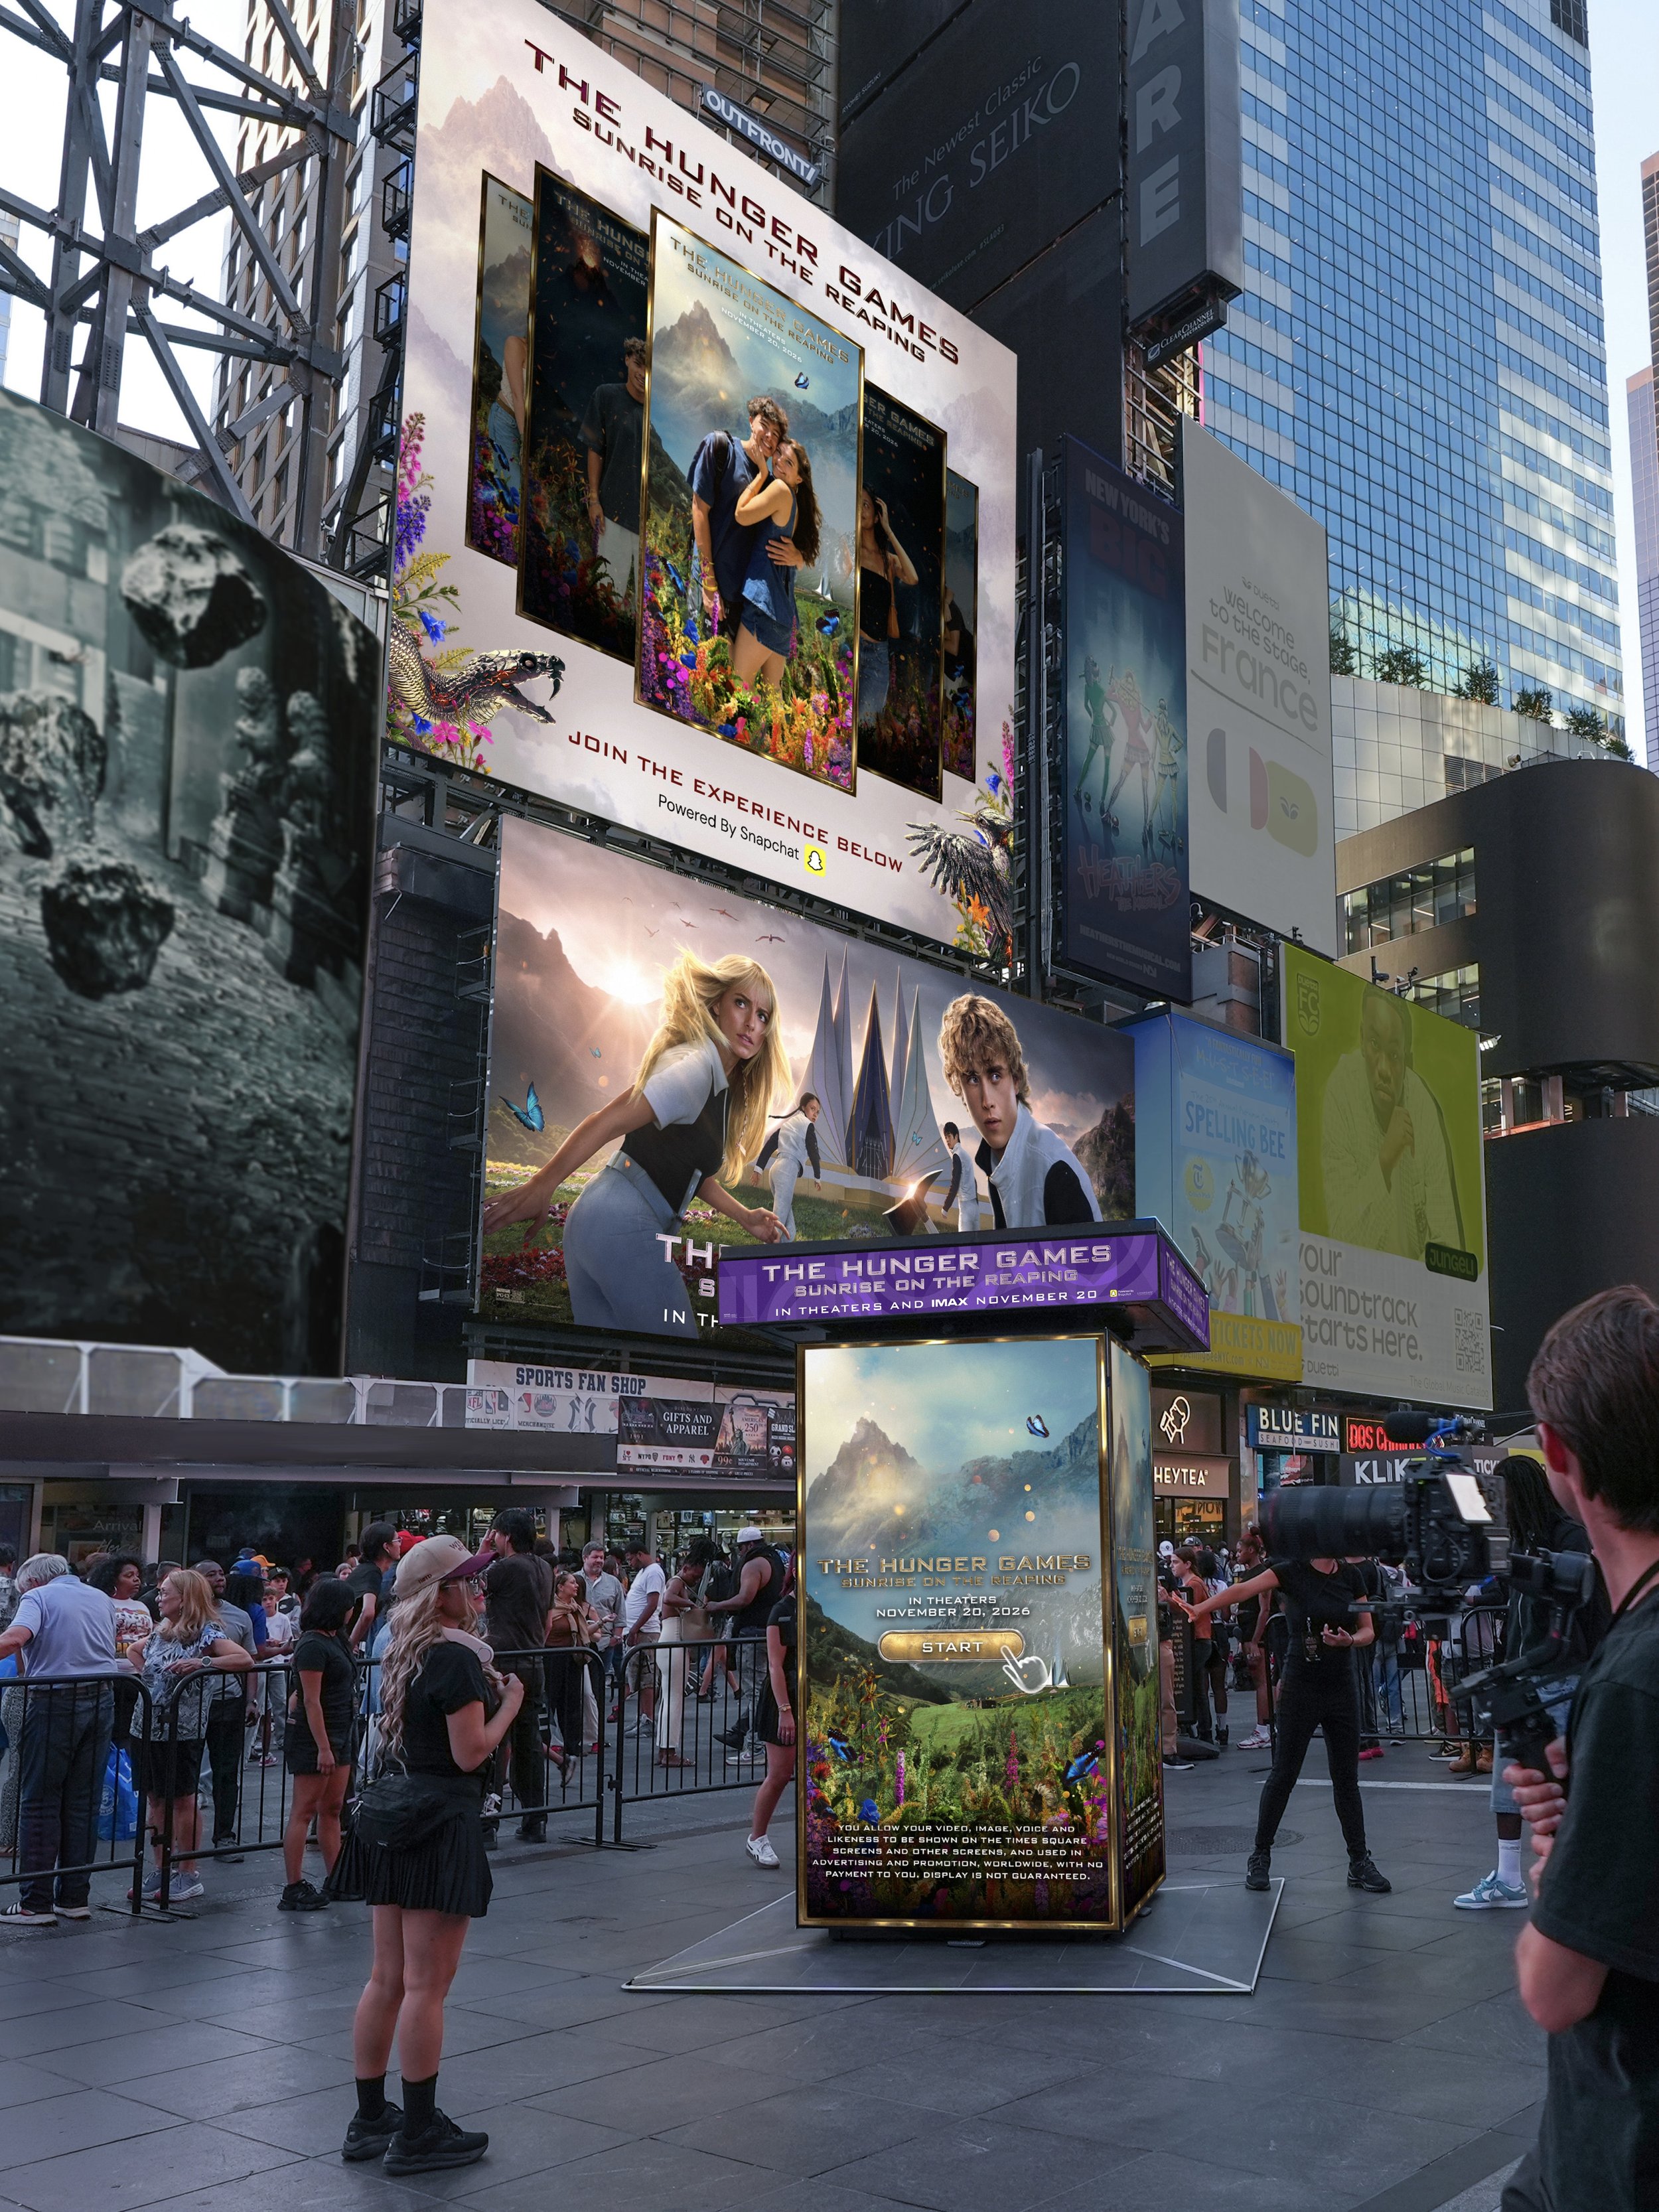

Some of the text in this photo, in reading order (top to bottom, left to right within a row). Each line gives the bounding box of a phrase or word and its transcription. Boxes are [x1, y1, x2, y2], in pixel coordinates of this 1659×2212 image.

[893, 56, 1041, 200] The Newest Classic
[968, 62, 1080, 188] SEIKO
[525, 39, 958, 364] THE HUNGER GAMES
[553, 190, 590, 223] THE
[573, 108, 924, 362] SUNRISE ON THE REAPING
[603, 257, 646, 287] NOVEMBER
[671, 236, 849, 364] THE HUNGER GAMES
[687, 263, 833, 364] SUNRISE ON THE REAPING
[721, 307, 802, 363] NOVEMBER 20, 2026
[749, 317, 785, 344] THEATERS
[891, 411, 934, 447] GAMES
[1085, 467, 1169, 545] NEW YORK'S
[1090, 502, 1168, 600] BIG
[1209, 598, 1229, 625] to
[1202, 621, 1318, 732] France
[569, 731, 902, 873] JOIN THE EXPERIENCE BELOW
[658, 794, 800, 860] Powered By Snapchat
[1078, 844, 1181, 906] HEATHERS
[1186, 1100, 1256, 1150] SPELLING
[1260, 1124, 1285, 1160] BEE
[762, 1244, 1112, 1282] THE HUNGER GAMES
[794, 1270, 1078, 1297] SUNRISE ON THE REAPING
[664, 1308, 685, 1324] IN
[776, 1290, 1096, 1317] IN THEATERS AND IMAX NOVEMBER 20
[1211, 1317, 1263, 1350] TICKETS
[1267, 1328, 1295, 1355] NOW
[516, 1367, 646, 1394] SPORTS FAN SHOP
[1409, 1375, 1422, 1388] The
[1423, 1377, 1445, 1392] Global
[1465, 1383, 1488, 1401] Catalog
[467, 1398, 481, 1408] NFL
[664, 1412, 712, 1424] GIFTS AND
[666, 1424, 709, 1436] APPAREL
[745, 1423, 758, 1433] 250
[771, 1424, 788, 1432] GRAND
[1259, 1407, 1338, 1437] BLUE FIN
[1260, 1434, 1339, 1449] SEAFOOD SUSHI
[1349, 1424, 1374, 1450] DOS
[1154, 1466, 1206, 1486] HEYTEA
[817, 1554, 1091, 1574] THE HUNGER GAMES
[840, 1574, 1066, 1588] SUNRISE ON THE REAPING
[876, 1607, 1031, 1618] NOVEMBER 20, 2026
[926, 1596, 996, 1605] THEATERS
[922, 1641, 983, 1653] START
